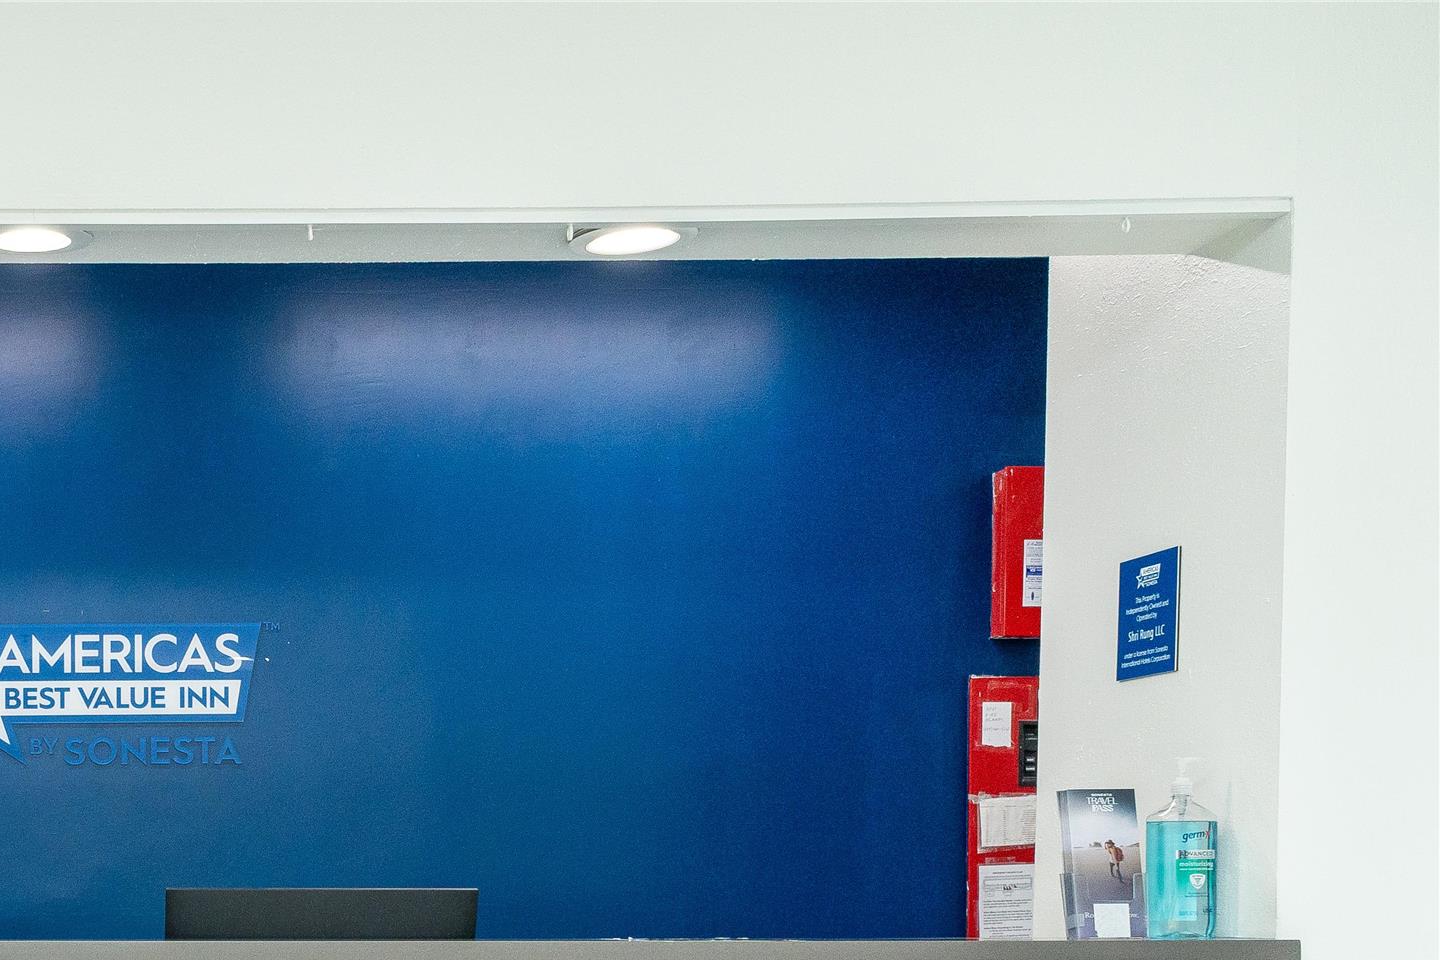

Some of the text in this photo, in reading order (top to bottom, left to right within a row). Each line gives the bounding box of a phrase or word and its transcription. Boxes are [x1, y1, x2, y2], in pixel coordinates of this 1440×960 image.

[1154, 624, 1166, 637] LLC
[4, 685, 230, 710] BEST VALUE INN
[29, 734, 243, 766] BY SONESTA
[1086, 796, 1119, 805] TRAVEL
[1091, 804, 1114, 812] PASS
